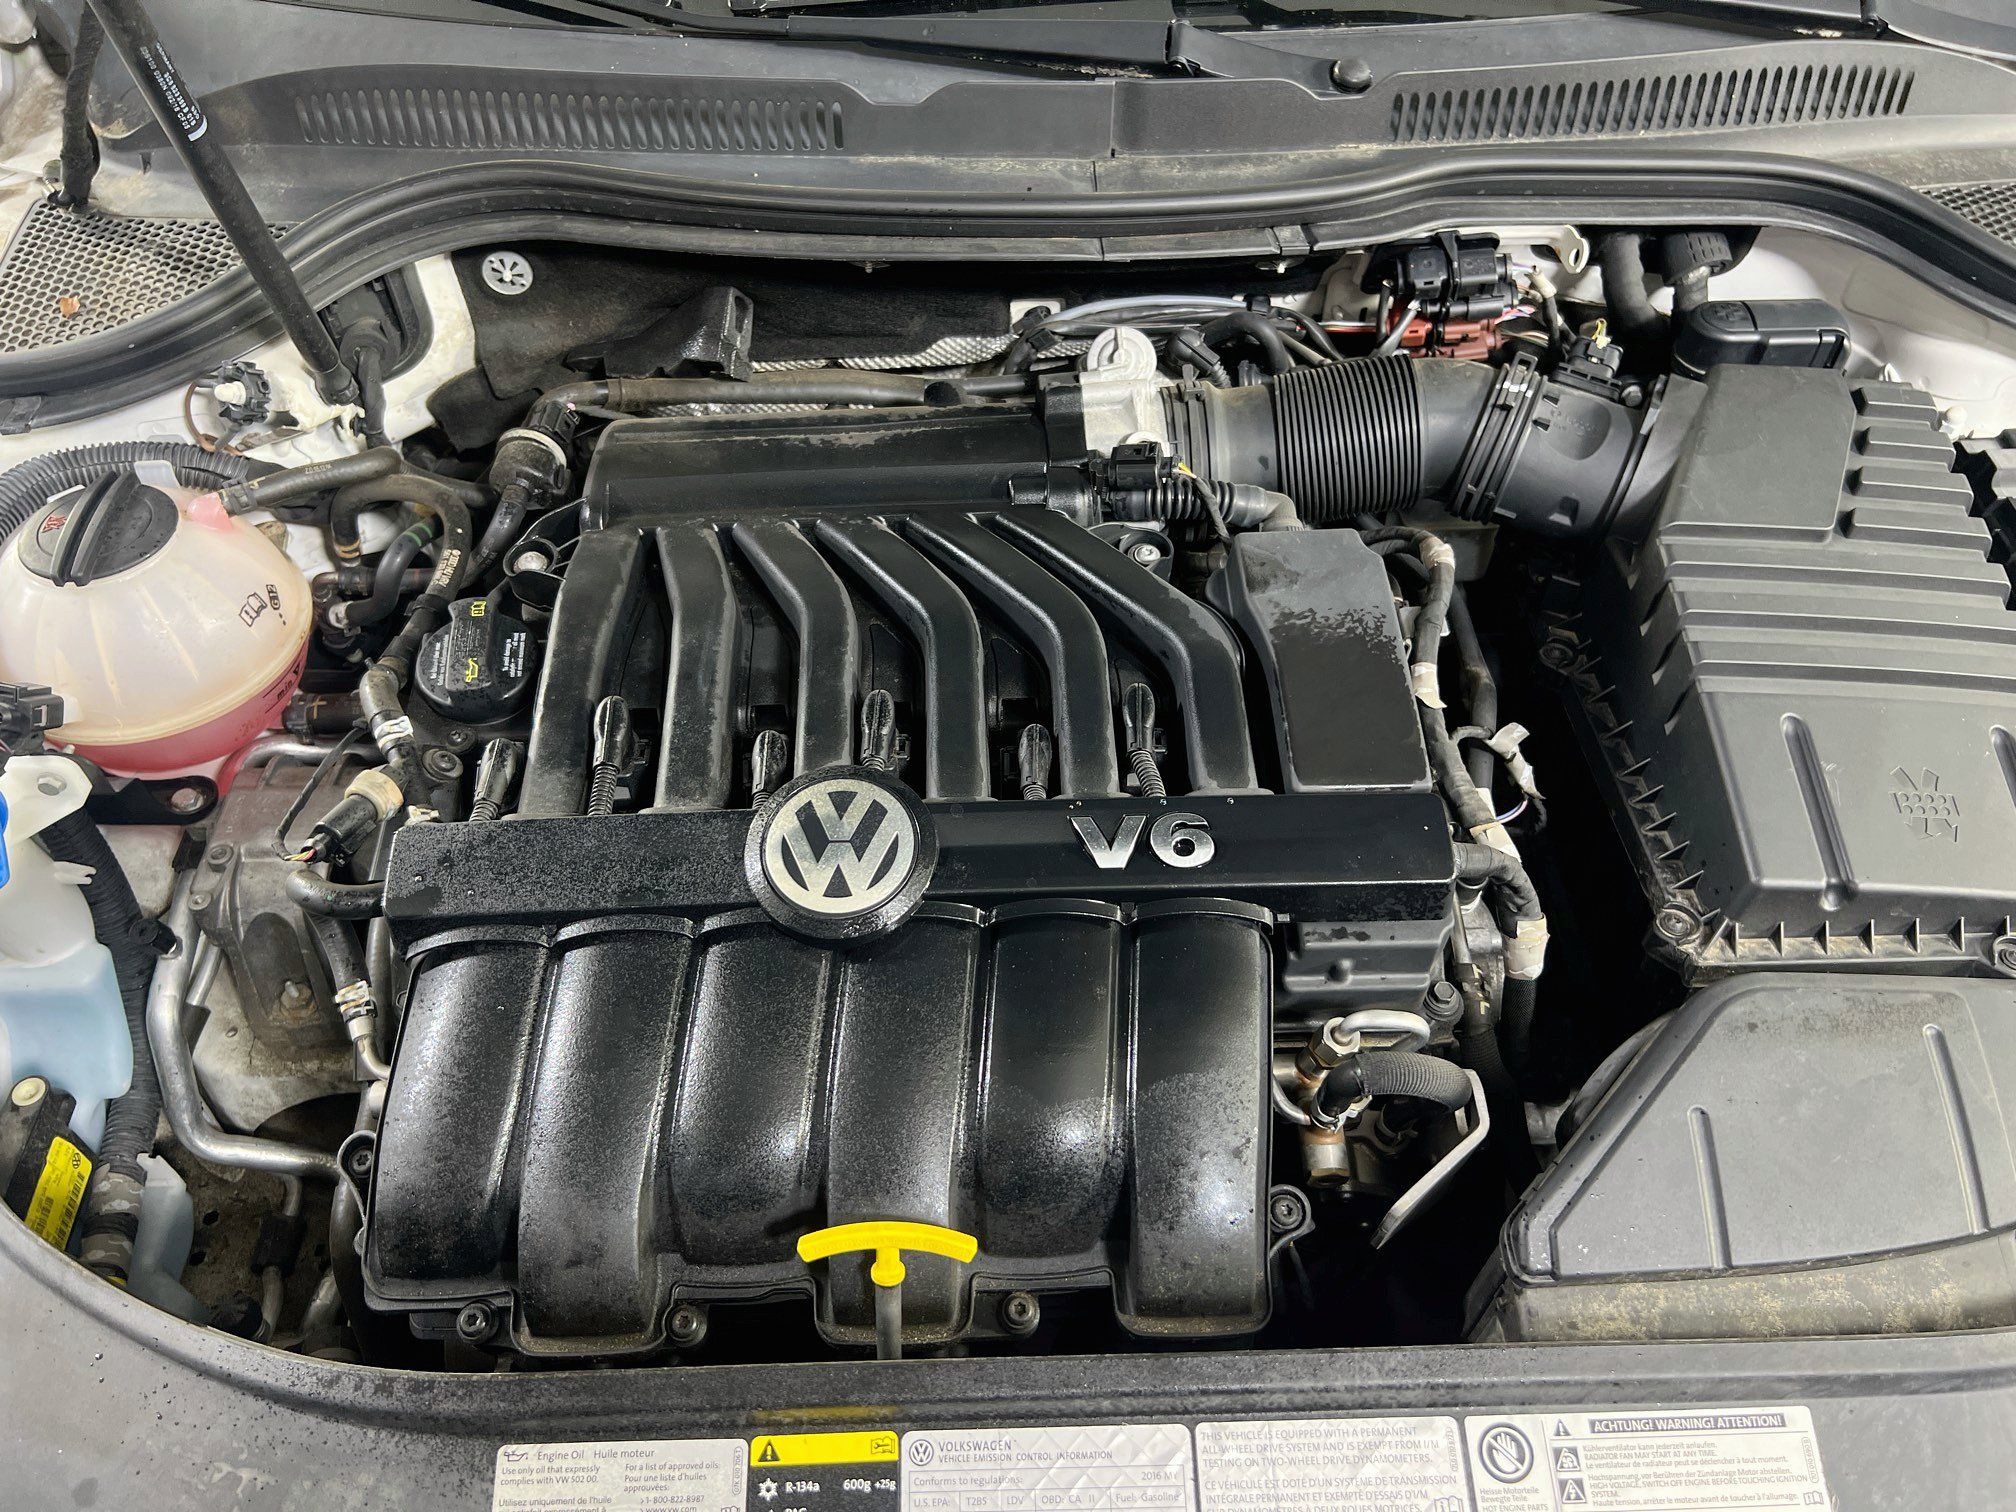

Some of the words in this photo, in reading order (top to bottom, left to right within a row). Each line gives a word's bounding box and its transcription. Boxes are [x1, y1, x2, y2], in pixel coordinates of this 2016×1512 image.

[277, 680, 293, 700] min
[1069, 812, 1215, 869] V6
[1594, 1420, 1654, 1432] ACHTUNG!
[1655, 1417, 1714, 1430] WARNING!
[1717, 1415, 1782, 1428] ATTENTION!
[1200, 1432, 1222, 1440] THIS
[1223, 1431, 1261, 1440] VEHICLE
[1264, 1430, 1273, 1439] IS
[1275, 1429, 1322, 1439] EQUIPPED
[1323, 1428, 1349, 1437] WITH
[1351, 1428, 1358, 1437] A
[1360, 1427, 1417, 1437] PERMANENT
[939, 1440, 1012, 1452] VOLKSWAGEN
[1202, 1444, 1254, 1454] ALL-WHEEL
[1256, 1443, 1284, 1453] DRIVE
[1286, 1442, 1320, 1452] SYSTEM
[1323, 1442, 1345, 1451] AND
[1346, 1441, 1355, 1450] IS
[1357, 1441, 1393, 1450] EXEMPT
[1395, 1440, 1422, 1449] FROM
[1424, 1439, 1440, 1449] I/M
[538, 1451, 569, 1462] Engine
[571, 1450, 584, 1459] Oil
[594, 1449, 618, 1459] Huile
[620, 1449, 655, 1458] moteur
[939, 1454, 970, 1463] VEHICLE
[973, 1453, 1012, 1462] EMISSION
[1016, 1452, 1052, 1461] CONTROL
[1057, 1451, 1113, 1459] INFORMATION
[1202, 1458, 1242, 1468] TESTING
[1244, 1458, 1260, 1467] ON
[1262, 1456, 1321, 1466] TWO-WHEEL
[1323, 1455, 1351, 1465] DRIVE
[1353, 1453, 1433, 1464] DYNAMOMETERS.
[502, 1467, 517, 1475] Use
[518, 1466, 534, 1476] only
[536, 1465, 546, 1473] oil
[547, 1465, 563, 1473] that
[565, 1464, 601, 1474] expressly
[625, 1463, 637, 1471] For
[645, 1462, 657, 1470] list
[658, 1462, 667, 1470] of
[668, 1462, 704, 1472] approved
[500, 1477, 535, 1487] complies
[536, 1476, 554, 1484] with
[555, 1476, 570, 1484] VW
[571, 1475, 585, 1483] 502
[624, 1474, 642, 1482] Pour
[660, 1473, 676, 1481] liste
[677, 1472, 707, 1481] d'huiles
[914, 1477, 955, 1486] Conforms
[970, 1475, 1023, 1486] regulations:
[1141, 1472, 1161, 1480] 2016
[1164, 1471, 1178, 1480] MY
[785, 1481, 820, 1493] R-134a
[843, 1479, 871, 1493] 600g
[1204, 1481, 1216, 1490] CE
[1265, 1479, 1280, 1489] EST
[1309, 1477, 1333, 1488] D'UN
[1375, 1477, 1388, 1486] DE
[1389, 1475, 1457, 1485] TRANSMISSION
[1642, 1480, 1669, 1488] SWITCH
[1684, 1478, 1711, 1486] ENGINE
[1738, 1476, 1775, 1484] TOUCHING
[623, 1483, 670, 1494] approuvées:
[499, 1499, 527, 1507] Utilisez
[529, 1497, 575, 1507] uniquement
[577, 1496, 587, 1505] de
[589, 1496, 612, 1504] l'huile
[914, 1499, 930, 1508] U.S.
[1007, 1496, 1024, 1505] LDV
[1042, 1495, 1064, 1504] OBD:
[1069, 1494, 1082, 1503] CA
[1141, 1492, 1179, 1502] Gasoline
[1256, 1492, 1311, 1503] PERMANENT
[1312, 1492, 1323, 1501] ET
[1365, 1490, 1404, 1500] D'ESSAIS
